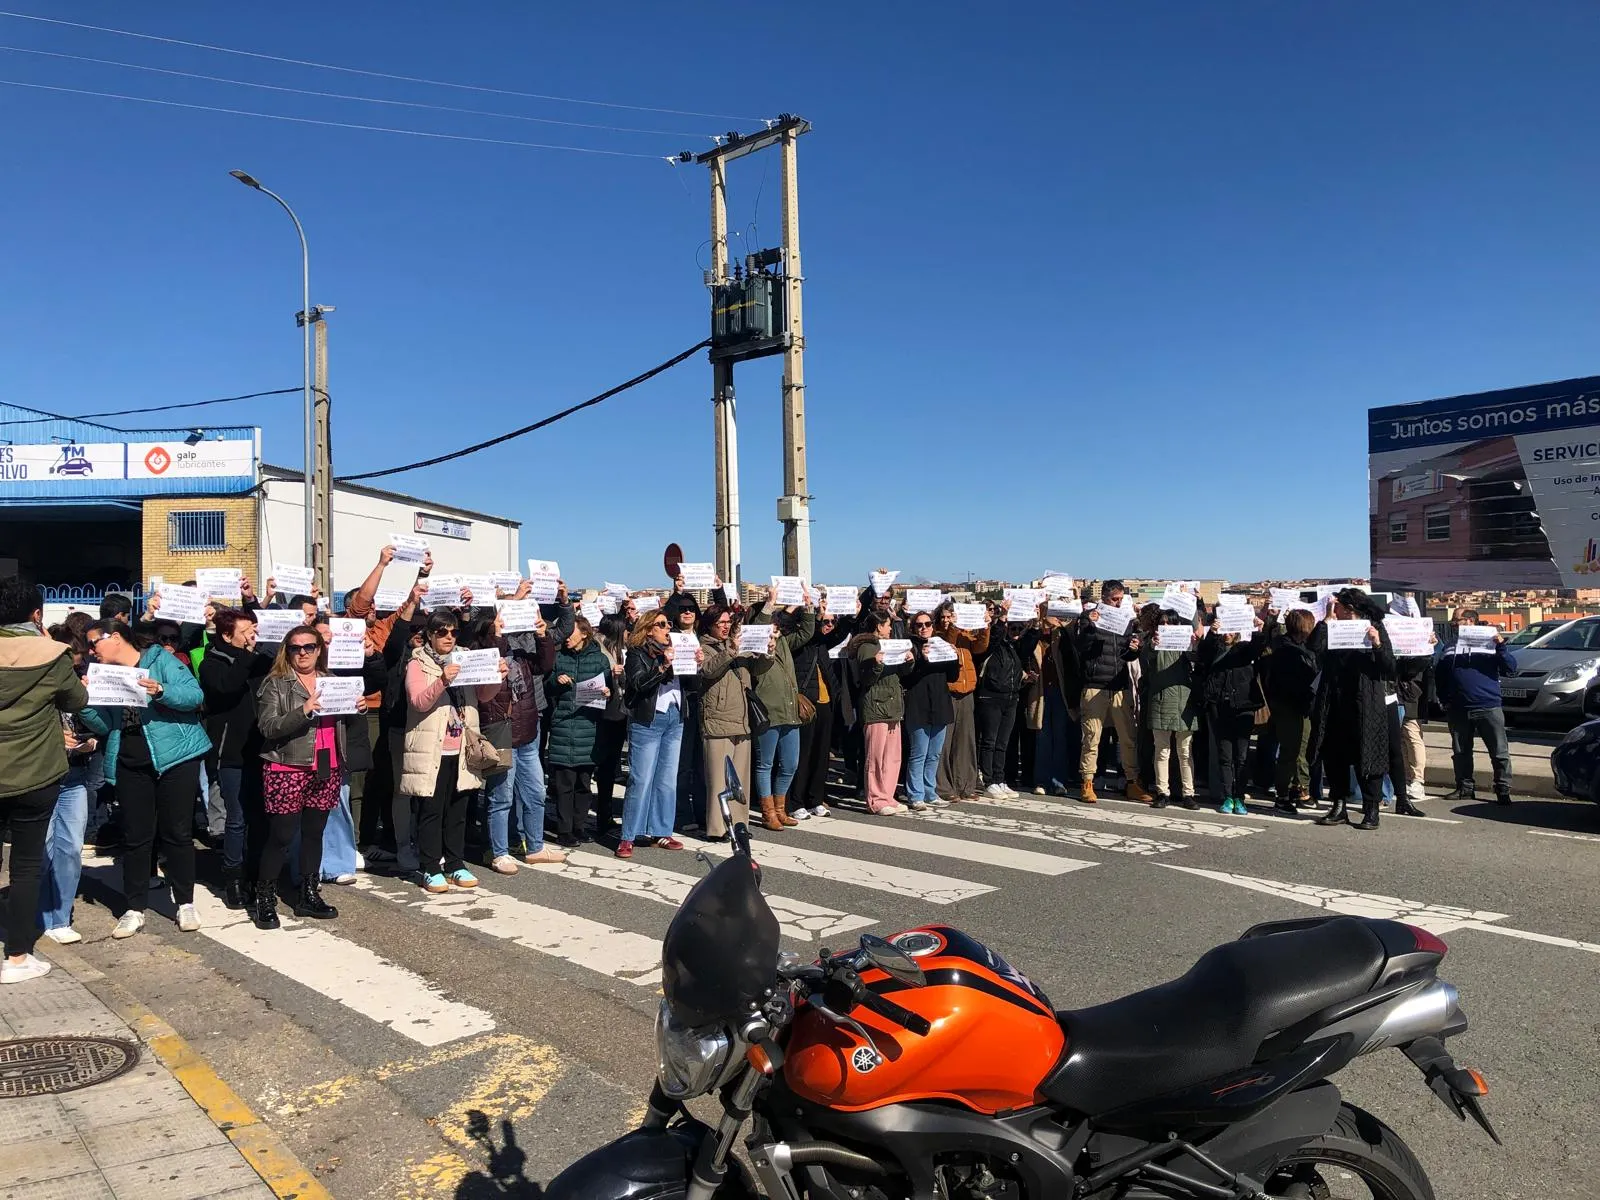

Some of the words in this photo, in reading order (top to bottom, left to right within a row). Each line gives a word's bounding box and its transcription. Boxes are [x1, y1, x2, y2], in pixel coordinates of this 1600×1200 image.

[1390, 418, 1452, 439] Juntos
[1457, 406, 1537, 430] somos
[1547, 395, 1600, 418] más
[61, 446, 85, 462] TM
[176, 451, 197, 461] galp
[177, 460, 226, 469] lubricantes
[1554, 477, 1573, 485] Uso
[1575, 475, 1588, 483] de
